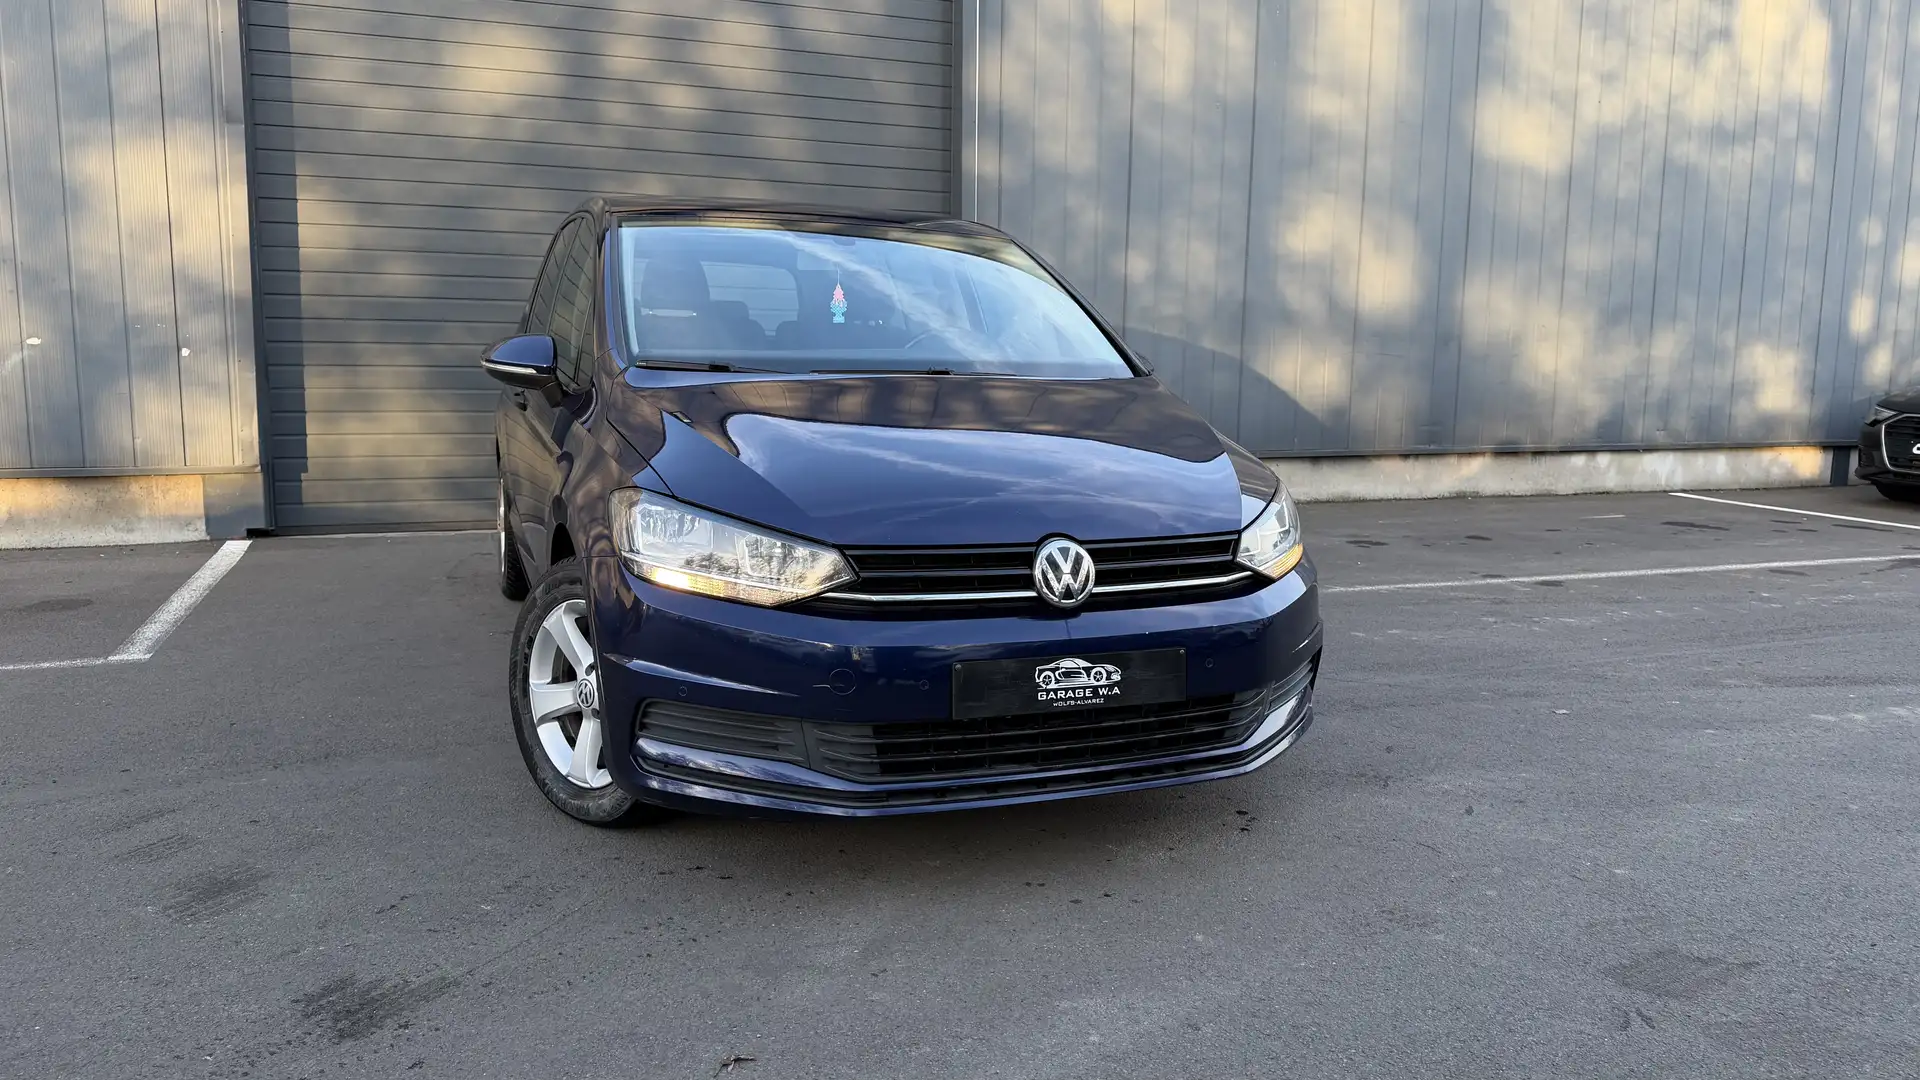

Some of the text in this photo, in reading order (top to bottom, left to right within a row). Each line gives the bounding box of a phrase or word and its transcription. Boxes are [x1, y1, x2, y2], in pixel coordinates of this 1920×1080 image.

[1036, 539, 1095, 605] VW
[1037, 686, 1120, 700] GARAGE W.A
[1053, 698, 1104, 707] WOLFS-ALVAREZ
